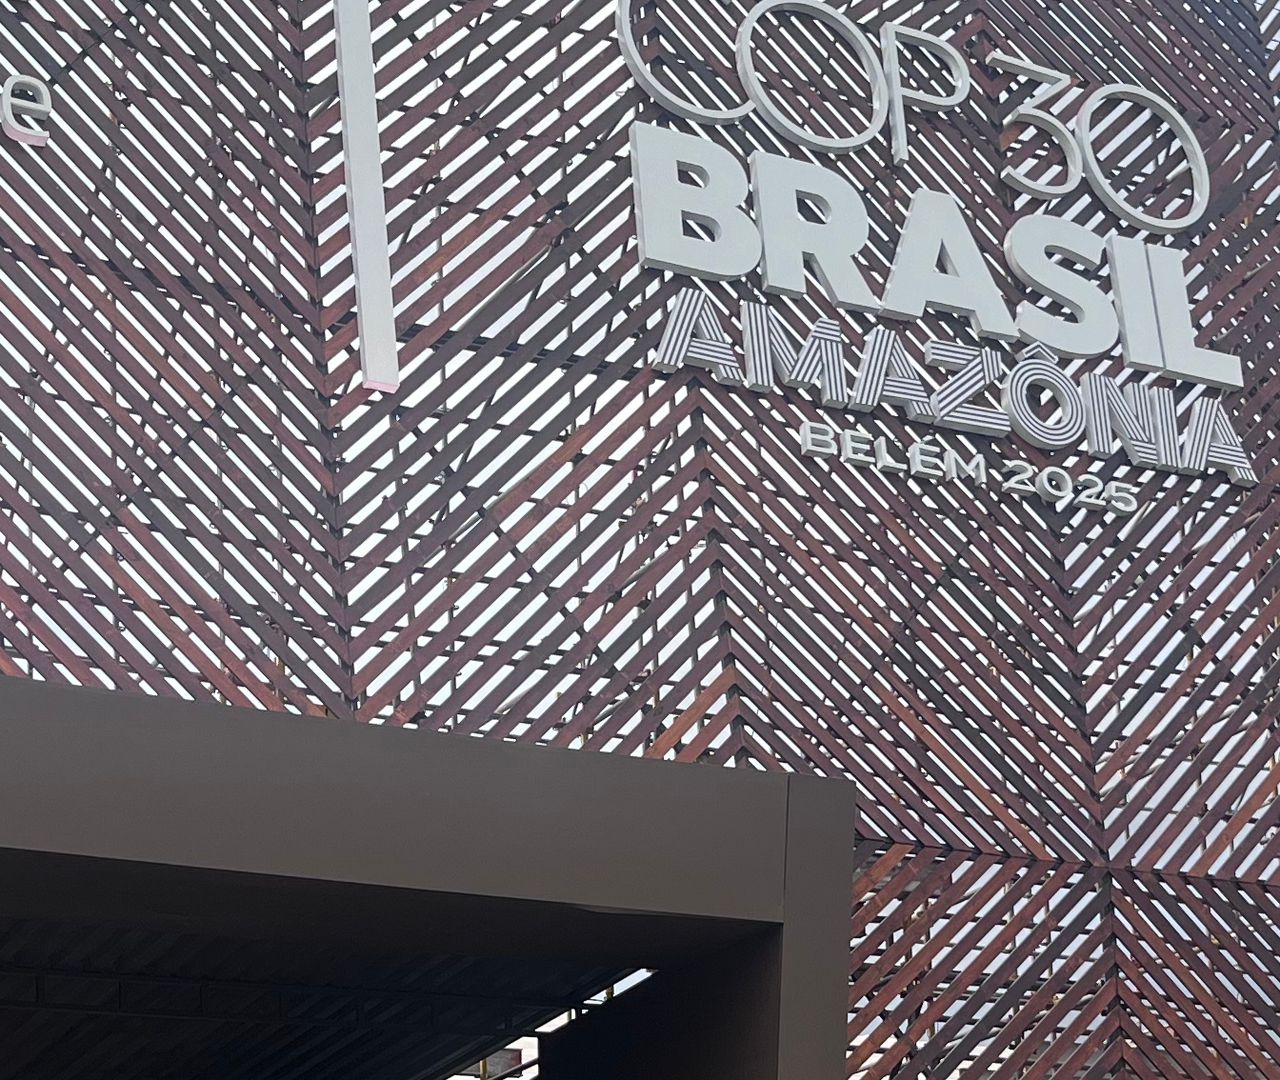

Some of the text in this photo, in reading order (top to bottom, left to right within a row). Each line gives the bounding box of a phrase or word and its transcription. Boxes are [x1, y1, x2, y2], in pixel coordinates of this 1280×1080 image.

[629, 120, 1244, 392] BRASIL
[654, 287, 1258, 487] AMAZÔNIA
[799, 421, 1139, 516] BELÉM 2025
